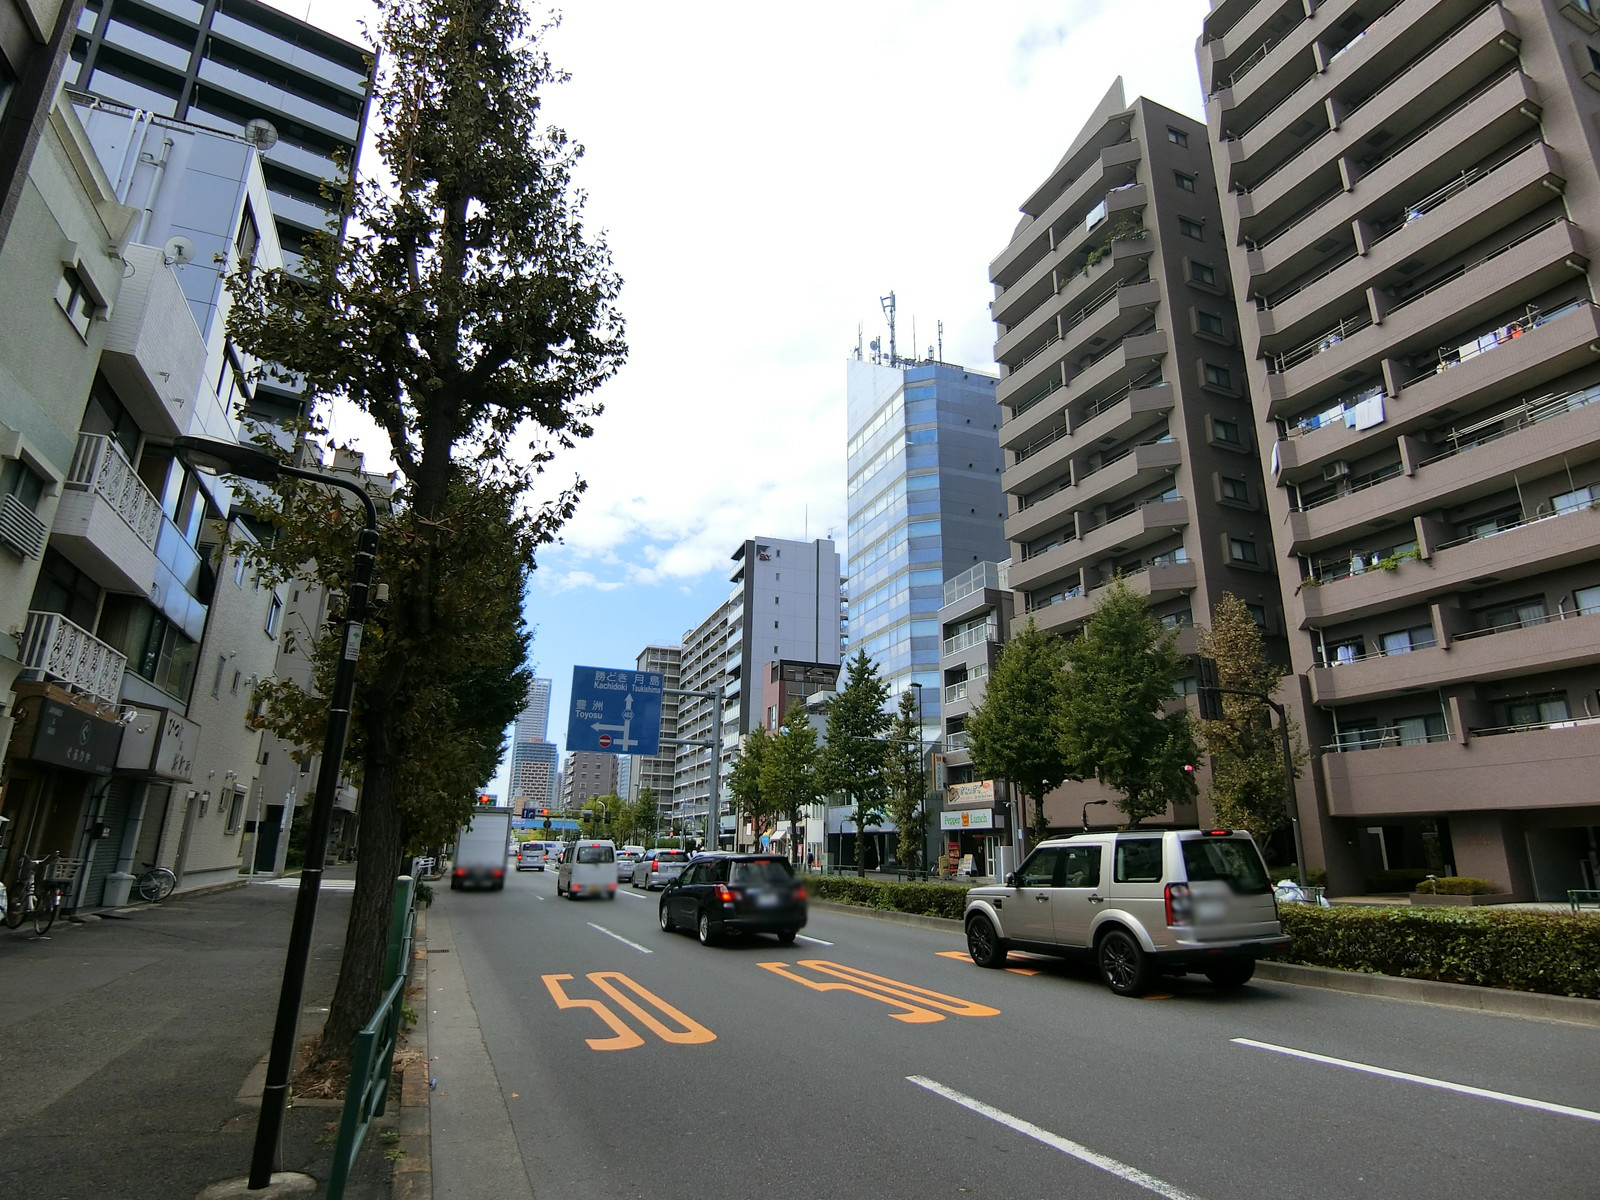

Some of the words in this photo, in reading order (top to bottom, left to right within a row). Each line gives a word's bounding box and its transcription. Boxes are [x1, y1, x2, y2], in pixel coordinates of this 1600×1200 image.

[595, 671, 627, 682] 勝どき
[634, 674, 660, 686] 月島
[594, 681, 627, 691] Kachidoki
[632, 684, 660, 693] Tsukishima
[576, 699, 604, 711] 豊洲
[576, 710, 602, 719] Toyosu
[944, 815, 961, 826] Pepper
[970, 813, 988, 824] Lunch
[755, 960, 1001, 1023] 50
[541, 971, 717, 1050] 50
